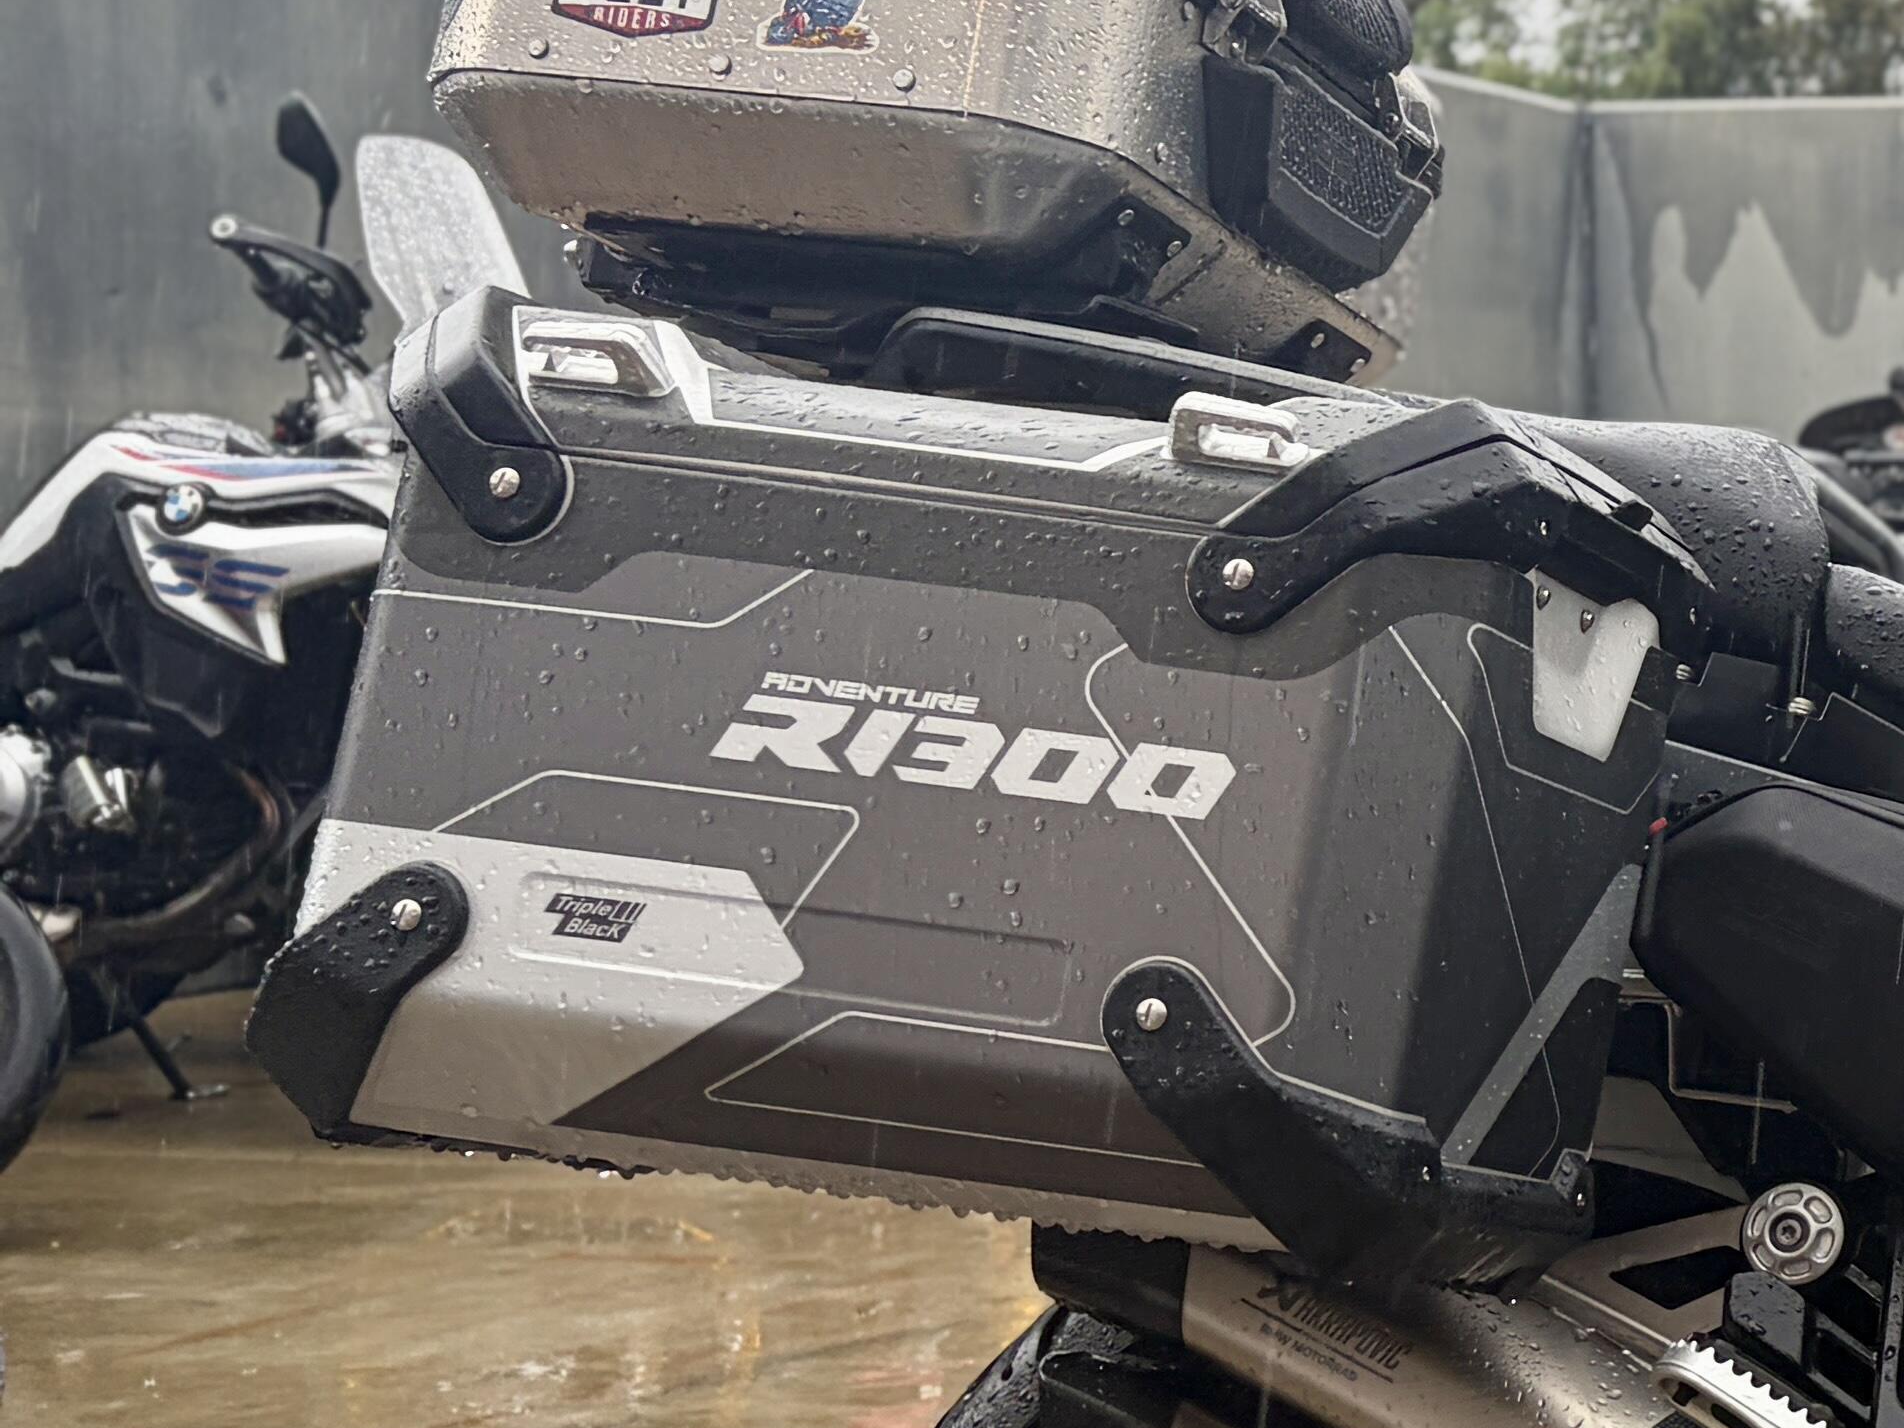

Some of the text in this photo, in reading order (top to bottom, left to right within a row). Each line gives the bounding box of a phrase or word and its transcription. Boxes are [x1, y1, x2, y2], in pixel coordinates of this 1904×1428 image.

[593, 6, 671, 29] RIDERS
[760, 670, 981, 716] ADVENTURE
[708, 692, 1238, 821] R1300
[554, 895, 613, 917] Triple
